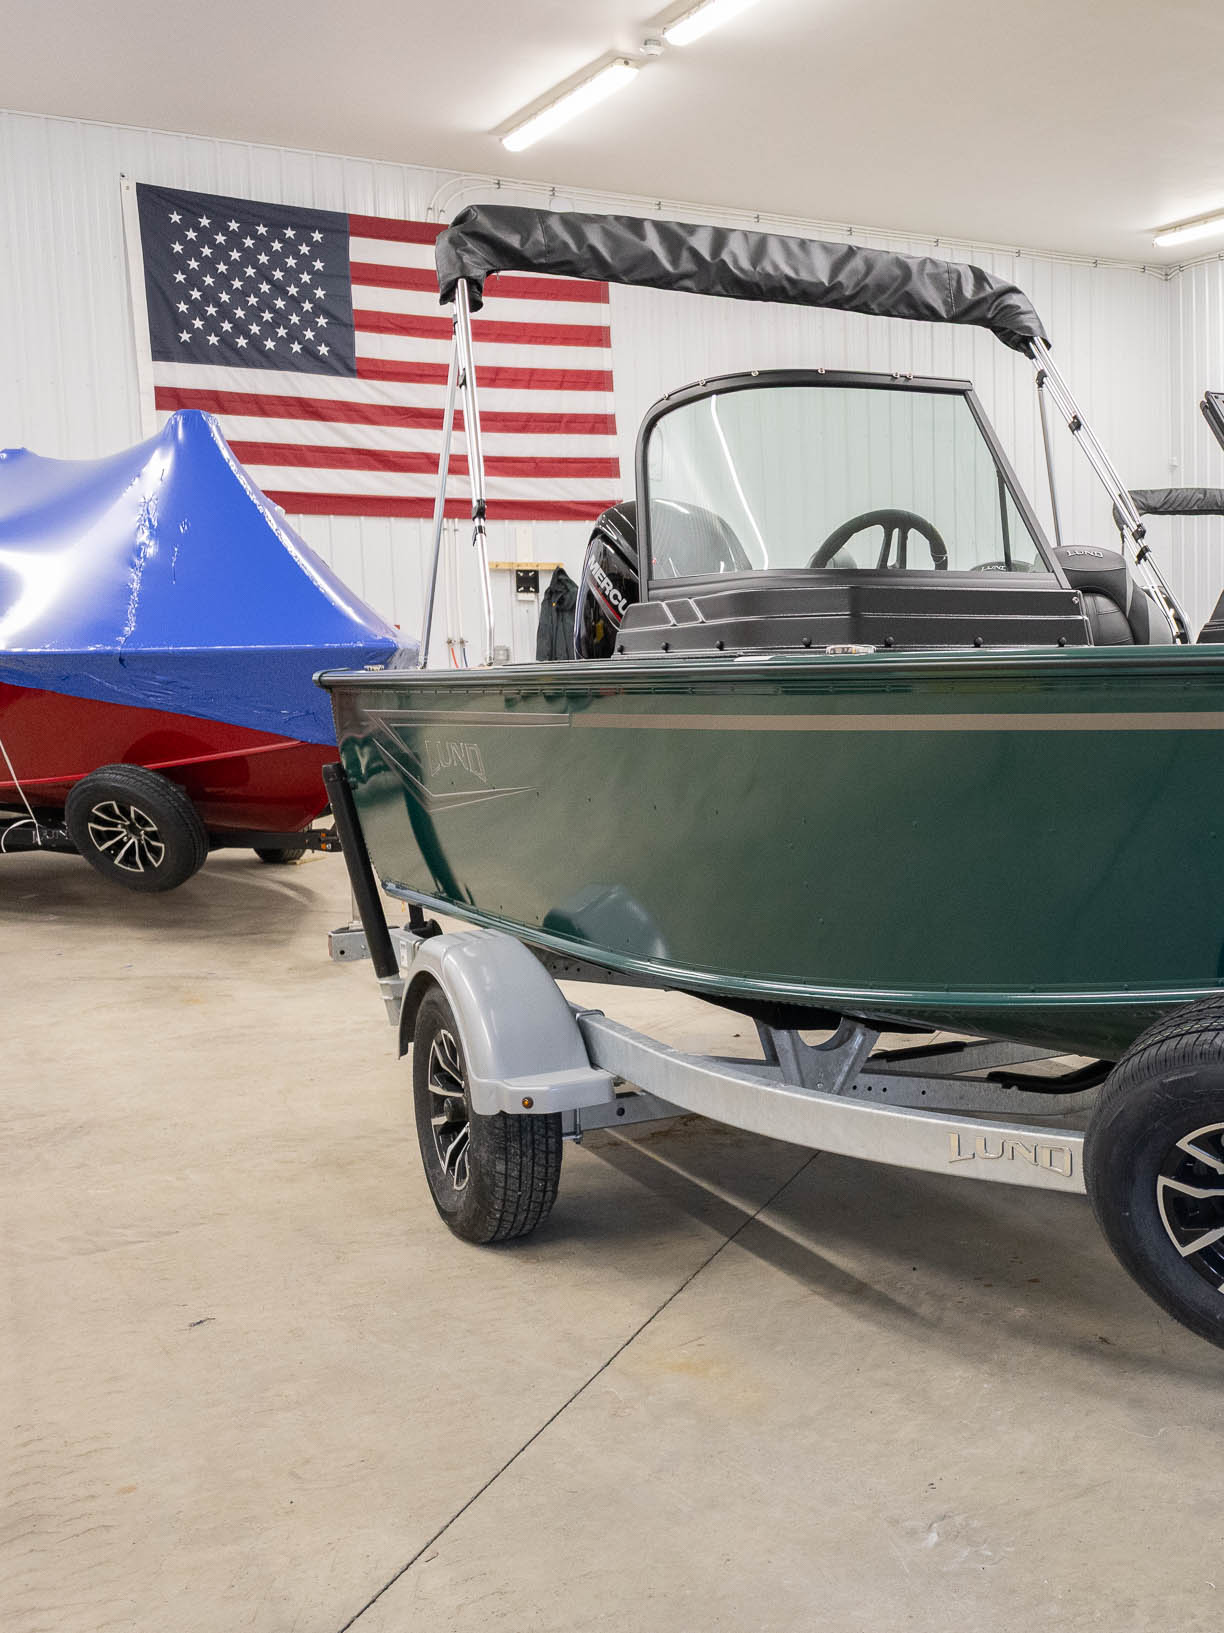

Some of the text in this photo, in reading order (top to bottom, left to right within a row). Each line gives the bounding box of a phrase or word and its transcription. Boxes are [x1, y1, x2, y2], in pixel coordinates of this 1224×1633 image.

[1066, 550, 1104, 558] LUND
[424, 739, 488, 784] LUND
[948, 1131, 1073, 1178] LUND
